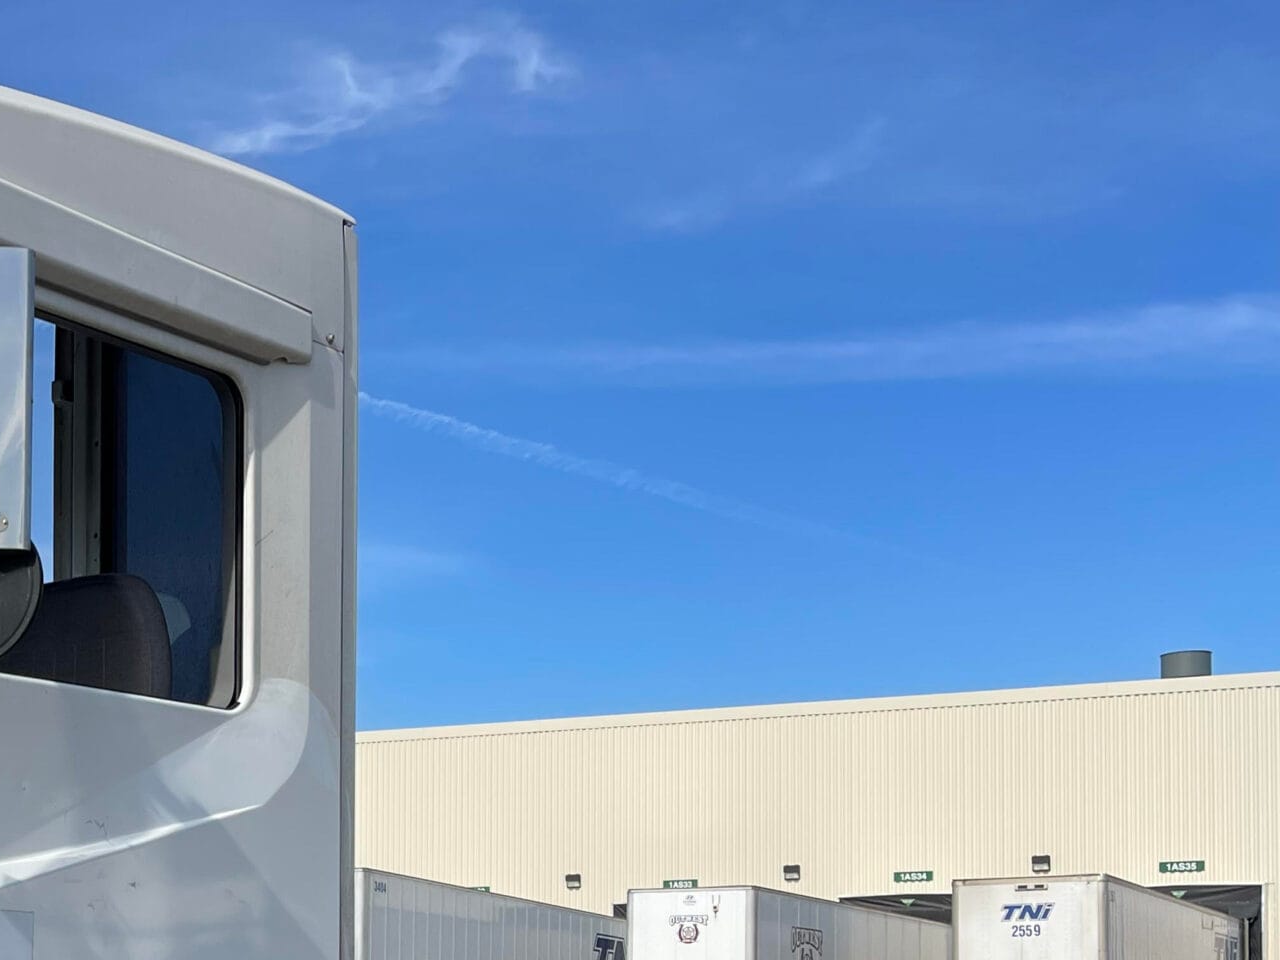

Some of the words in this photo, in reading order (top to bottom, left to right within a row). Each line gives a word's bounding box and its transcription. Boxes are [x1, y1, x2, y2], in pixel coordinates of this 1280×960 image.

[1166, 862, 1197, 871] 1AS35
[900, 872, 927, 881] 1AS34
[668, 881, 693, 889] 1AS33
[1011, 924, 1041, 938] 2559
